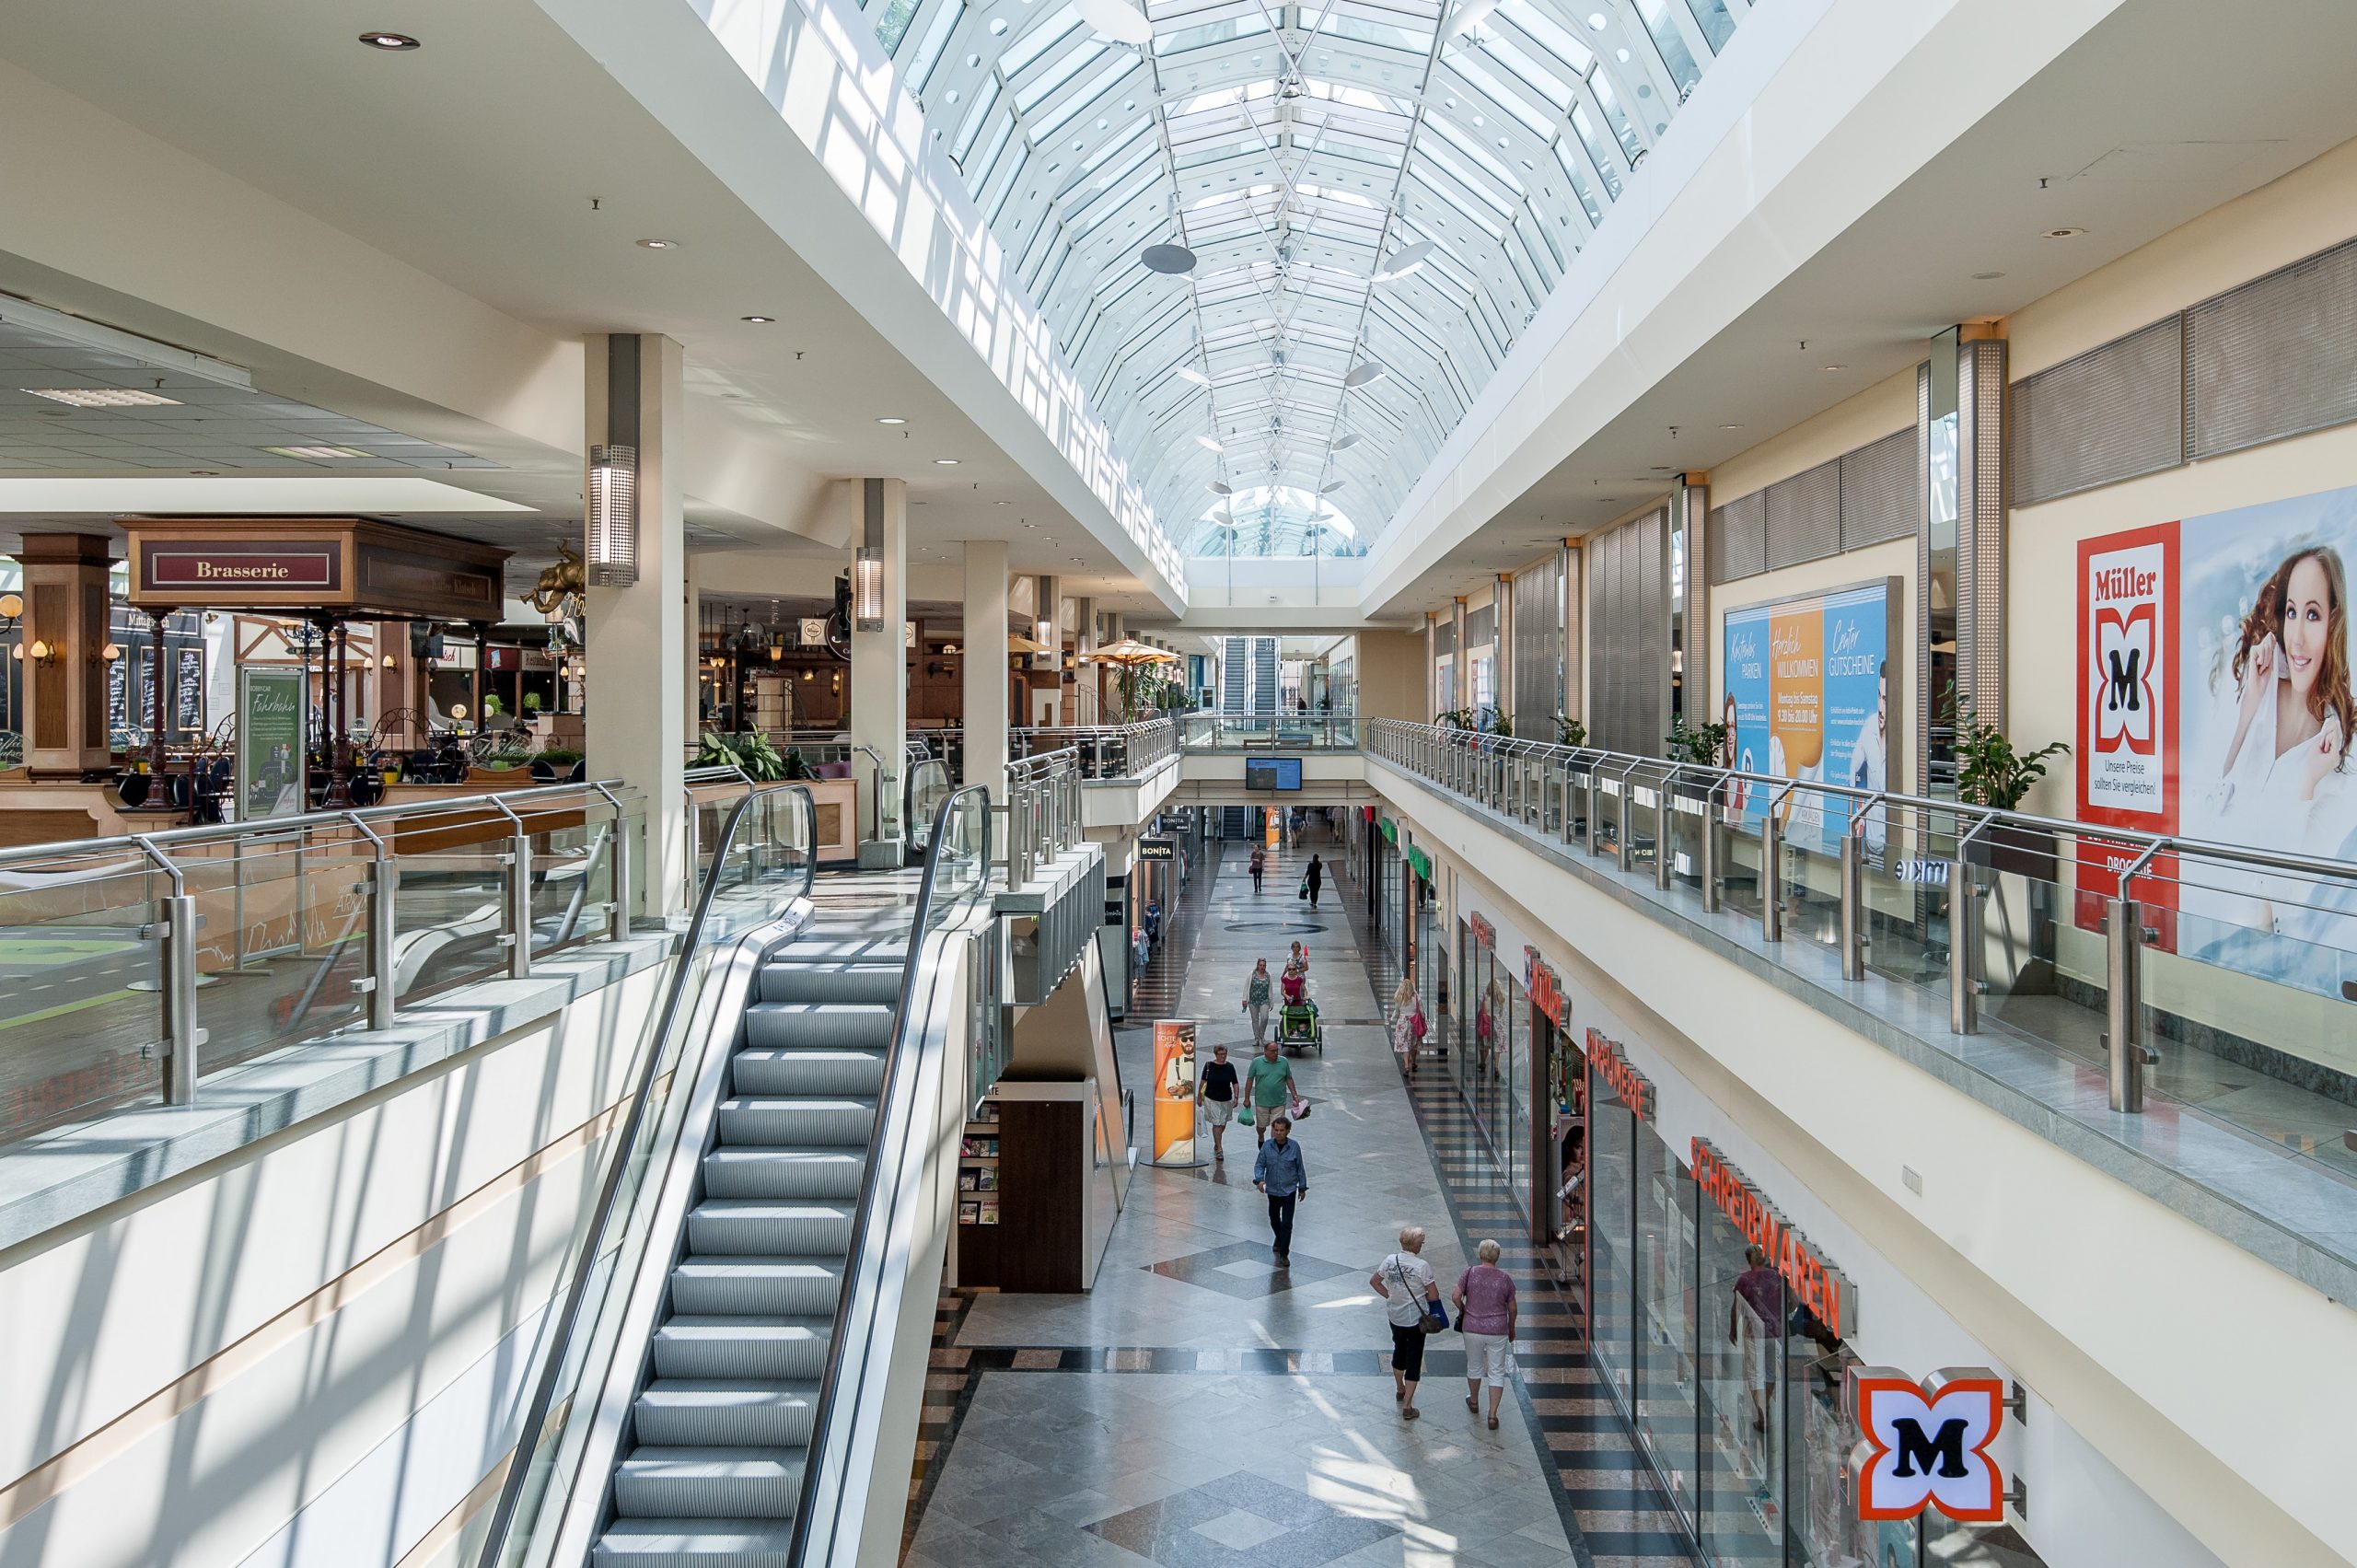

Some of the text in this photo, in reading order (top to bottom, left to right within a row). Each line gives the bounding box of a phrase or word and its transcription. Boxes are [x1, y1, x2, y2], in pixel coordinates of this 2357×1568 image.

[196, 561, 289, 579] Brasserie
[2095, 565, 2156, 601] Müller
[1771, 626, 1802, 661] Herzlich
[1831, 619, 1861, 655] Center
[1741, 662, 1762, 679] PARKEN
[1776, 658, 1818, 679] WILLKOMMEN
[1829, 654, 1875, 677] GUTSCHEINE
[2108, 647, 2141, 712] M
[1777, 691, 1793, 708] Montag
[1800, 691, 1818, 709] Samstag
[1777, 708, 1787, 723] 9.30
[1795, 708, 1808, 724] 20.00
[1809, 708, 1818, 724] Uhr
[2105, 759, 2145, 776] Unsere Preise
[2094, 777, 2156, 796] sollten Sie vergleichen!
[1142, 846, 1171, 856] BONITA
[1585, 1027, 1644, 1121] PARFÜMERIE
[1689, 1135, 1840, 1341] SCHREIBWAREN
[1891, 1417, 1969, 1479] M
